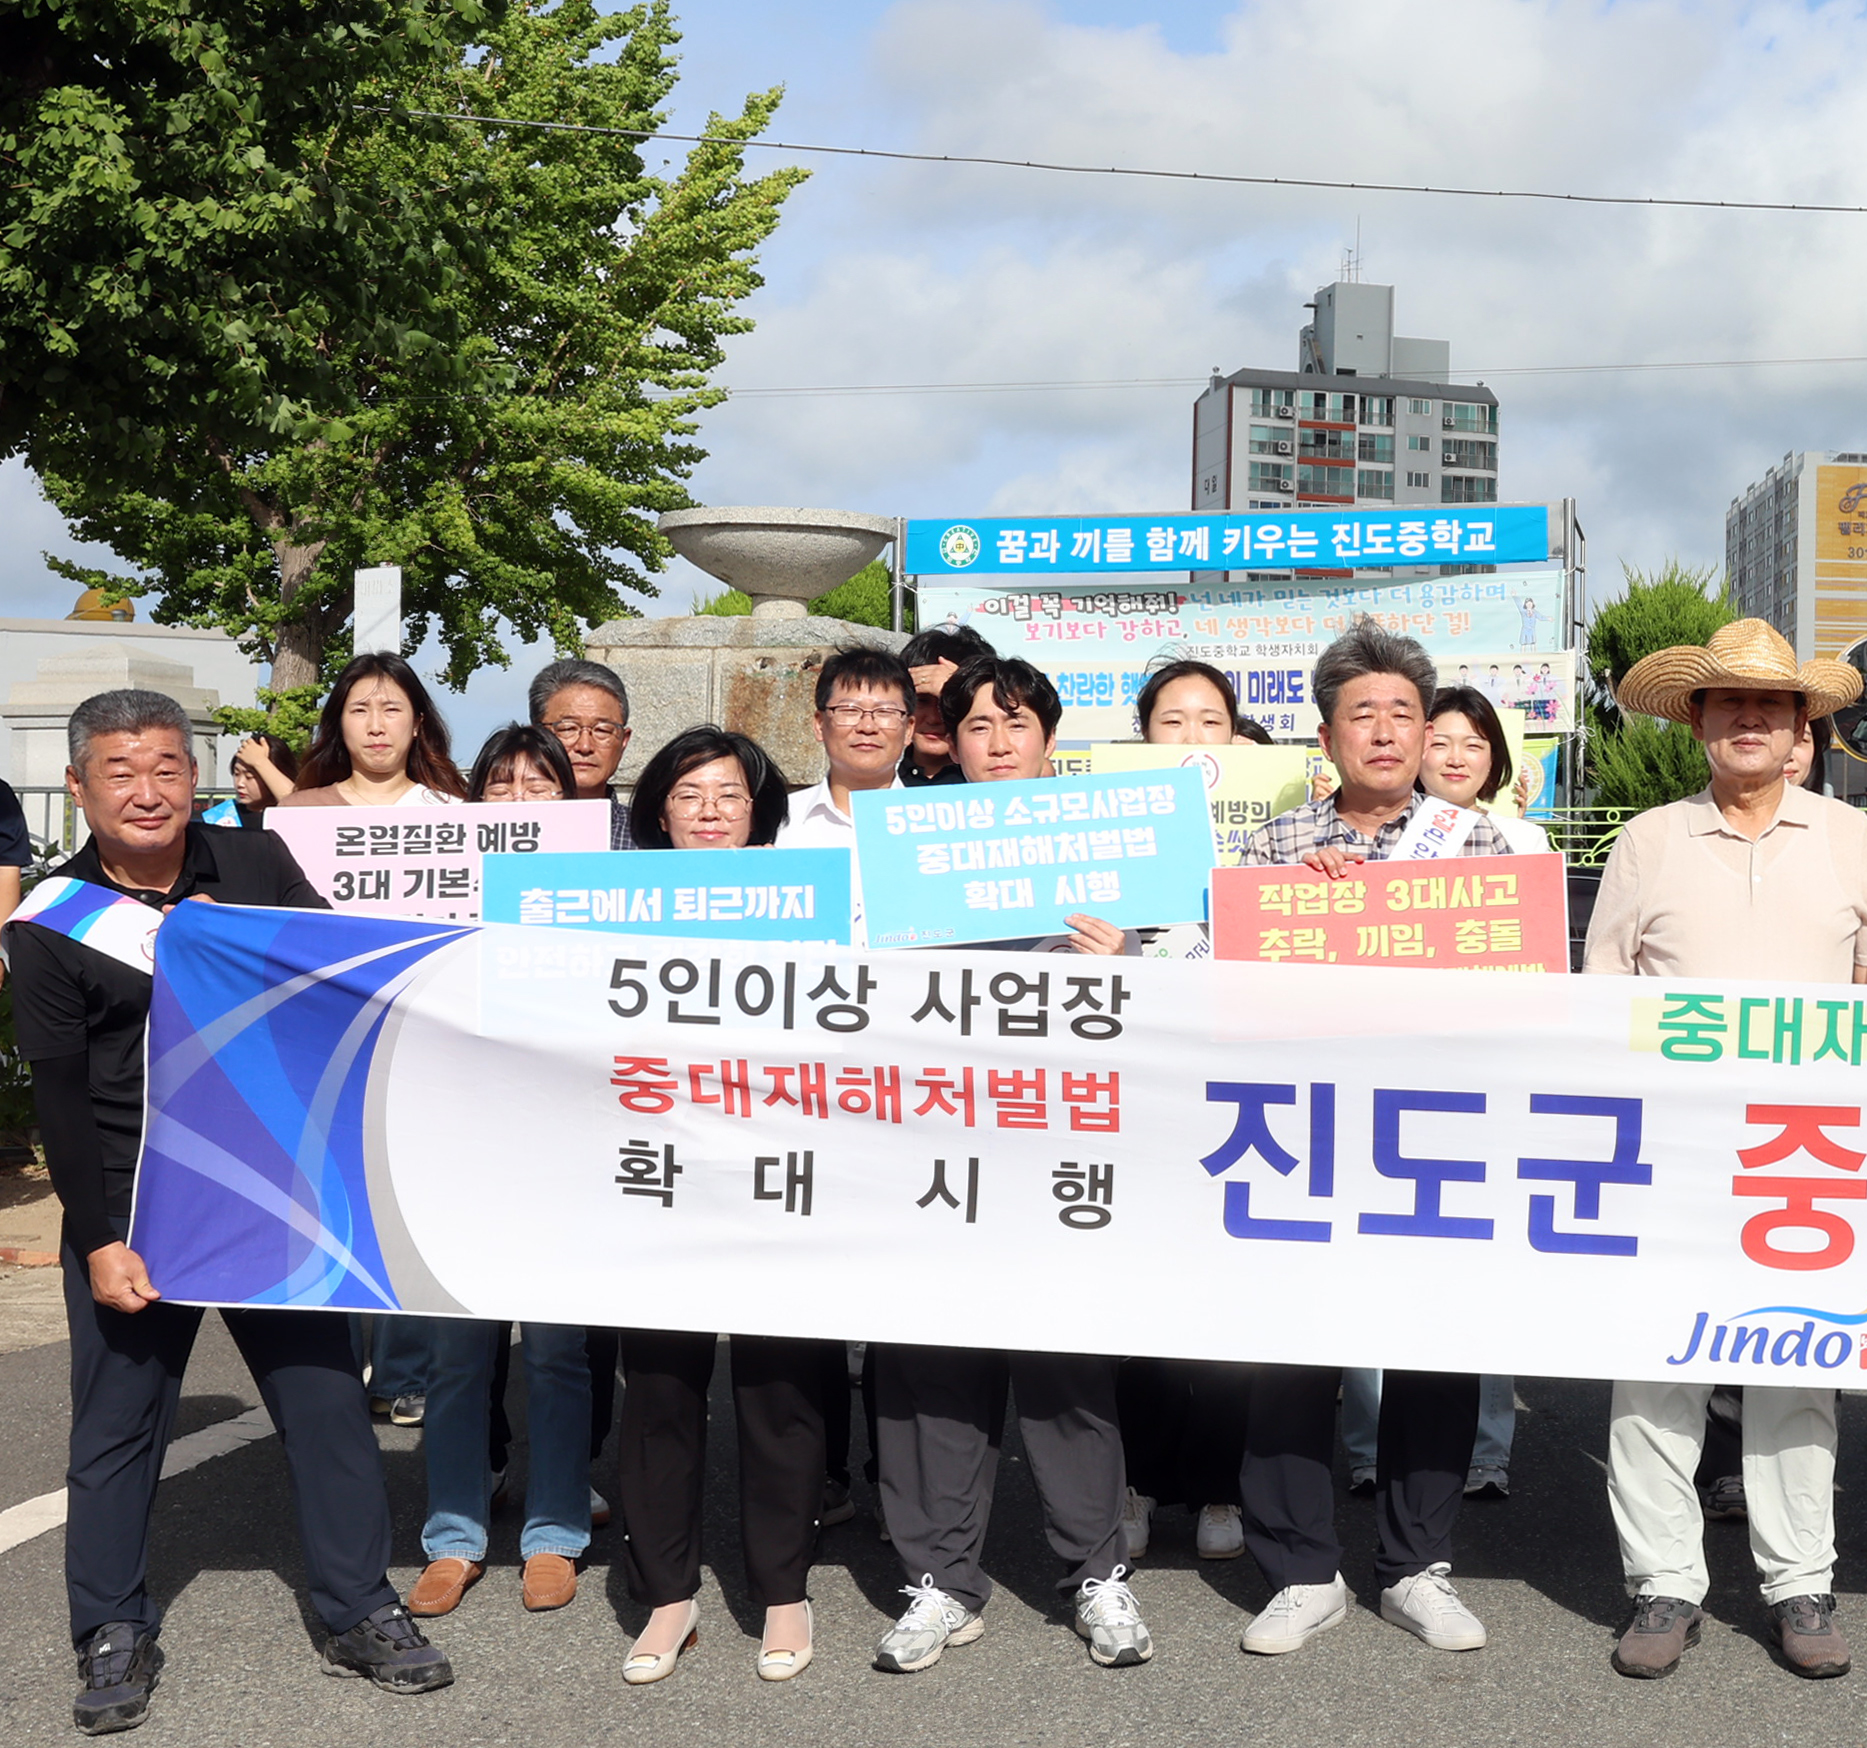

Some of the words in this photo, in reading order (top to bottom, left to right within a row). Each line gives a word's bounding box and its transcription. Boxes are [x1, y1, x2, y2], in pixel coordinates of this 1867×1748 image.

[996, 529, 1060, 564] 꿈과
[1070, 528, 1135, 563] 끼를
[1146, 526, 1209, 562] 함께
[1222, 524, 1319, 560] 키우는
[1331, 519, 1496, 558] 진도중학교
[984, 592, 1032, 622] 이걸
[1039, 592, 1063, 618] 꼭
[1070, 590, 1179, 617] 기억해줘!
[1219, 590, 1266, 610] 네가
[1274, 588, 1312, 612] 믿는
[1318, 586, 1382, 610] 것보다
[1390, 584, 1412, 604] 더
[1420, 582, 1506, 609] 용감하며
[1024, 618, 1107, 642] 보기보다
[1115, 617, 1188, 641] 강하고,
[1194, 618, 1219, 638] 네
[1226, 616, 1315, 639] 생각보다
[1323, 614, 1346, 635] 더
[1442, 611, 1471, 637] 걸!
[1187, 644, 1251, 660] 진도중학교
[1256, 643, 1319, 658] 학생자치회
[1057, 672, 1115, 707] 찬란한
[1247, 670, 1304, 705] 미래도
[885, 796, 995, 836] 5인이상
[1004, 784, 1177, 827] 소규모사업장
[335, 824, 466, 857] 온열질환
[476, 821, 541, 853] 예방
[916, 826, 1157, 876] 중대재해처벌법
[333, 869, 390, 901] 3대
[403, 867, 479, 900] 기본
[520, 887, 662, 925] 출근에서
[672, 884, 816, 921] 퇴근까지
[963, 878, 1035, 911] 확대
[1054, 870, 1122, 906] 시행
[1259, 880, 1367, 917] 작업장
[1385, 873, 1520, 912] 3대사고
[1259, 926, 1338, 963] 추락,
[1356, 923, 1436, 959] 끼임,
[1454, 918, 1522, 954] 충돌
[607, 957, 878, 1034] 5인이상
[910, 967, 1132, 1042] 사업장
[609, 1054, 1122, 1134] 중대재해처벌법
[1198, 1080, 1654, 1257] 진도군
[1666, 1311, 1853, 1370] Jindo
